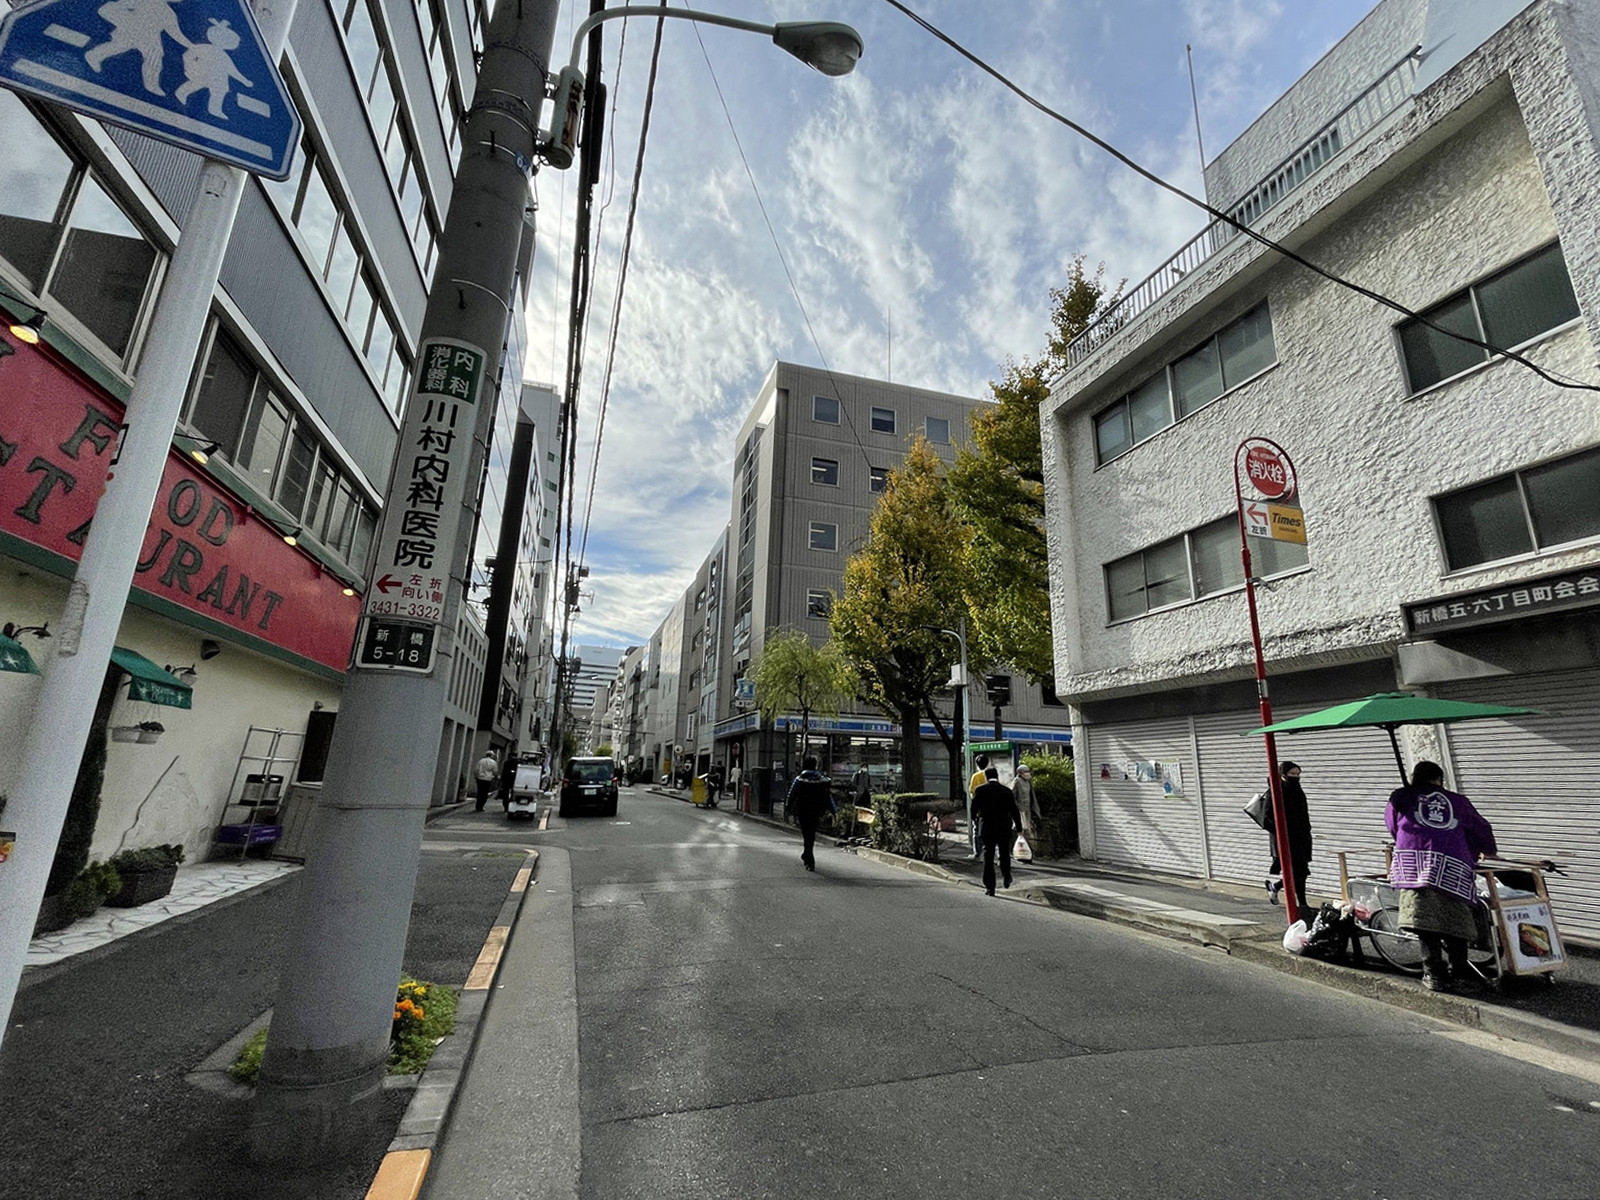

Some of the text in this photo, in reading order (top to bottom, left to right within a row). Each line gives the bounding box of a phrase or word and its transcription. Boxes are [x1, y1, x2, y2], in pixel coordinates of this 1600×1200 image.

[425, 346, 452, 391] 消化器科
[448, 351, 475, 398] 内科
[1248, 458, 1285, 485] 消火栓
[394, 399, 458, 570] 川村内科医院
[1272, 511, 1302, 528] Times
[409, 573, 443, 591] 左折
[369, 600, 441, 620] 3431-3322
[375, 628, 425, 646] 新橋
[373, 646, 420, 663] 5-18
